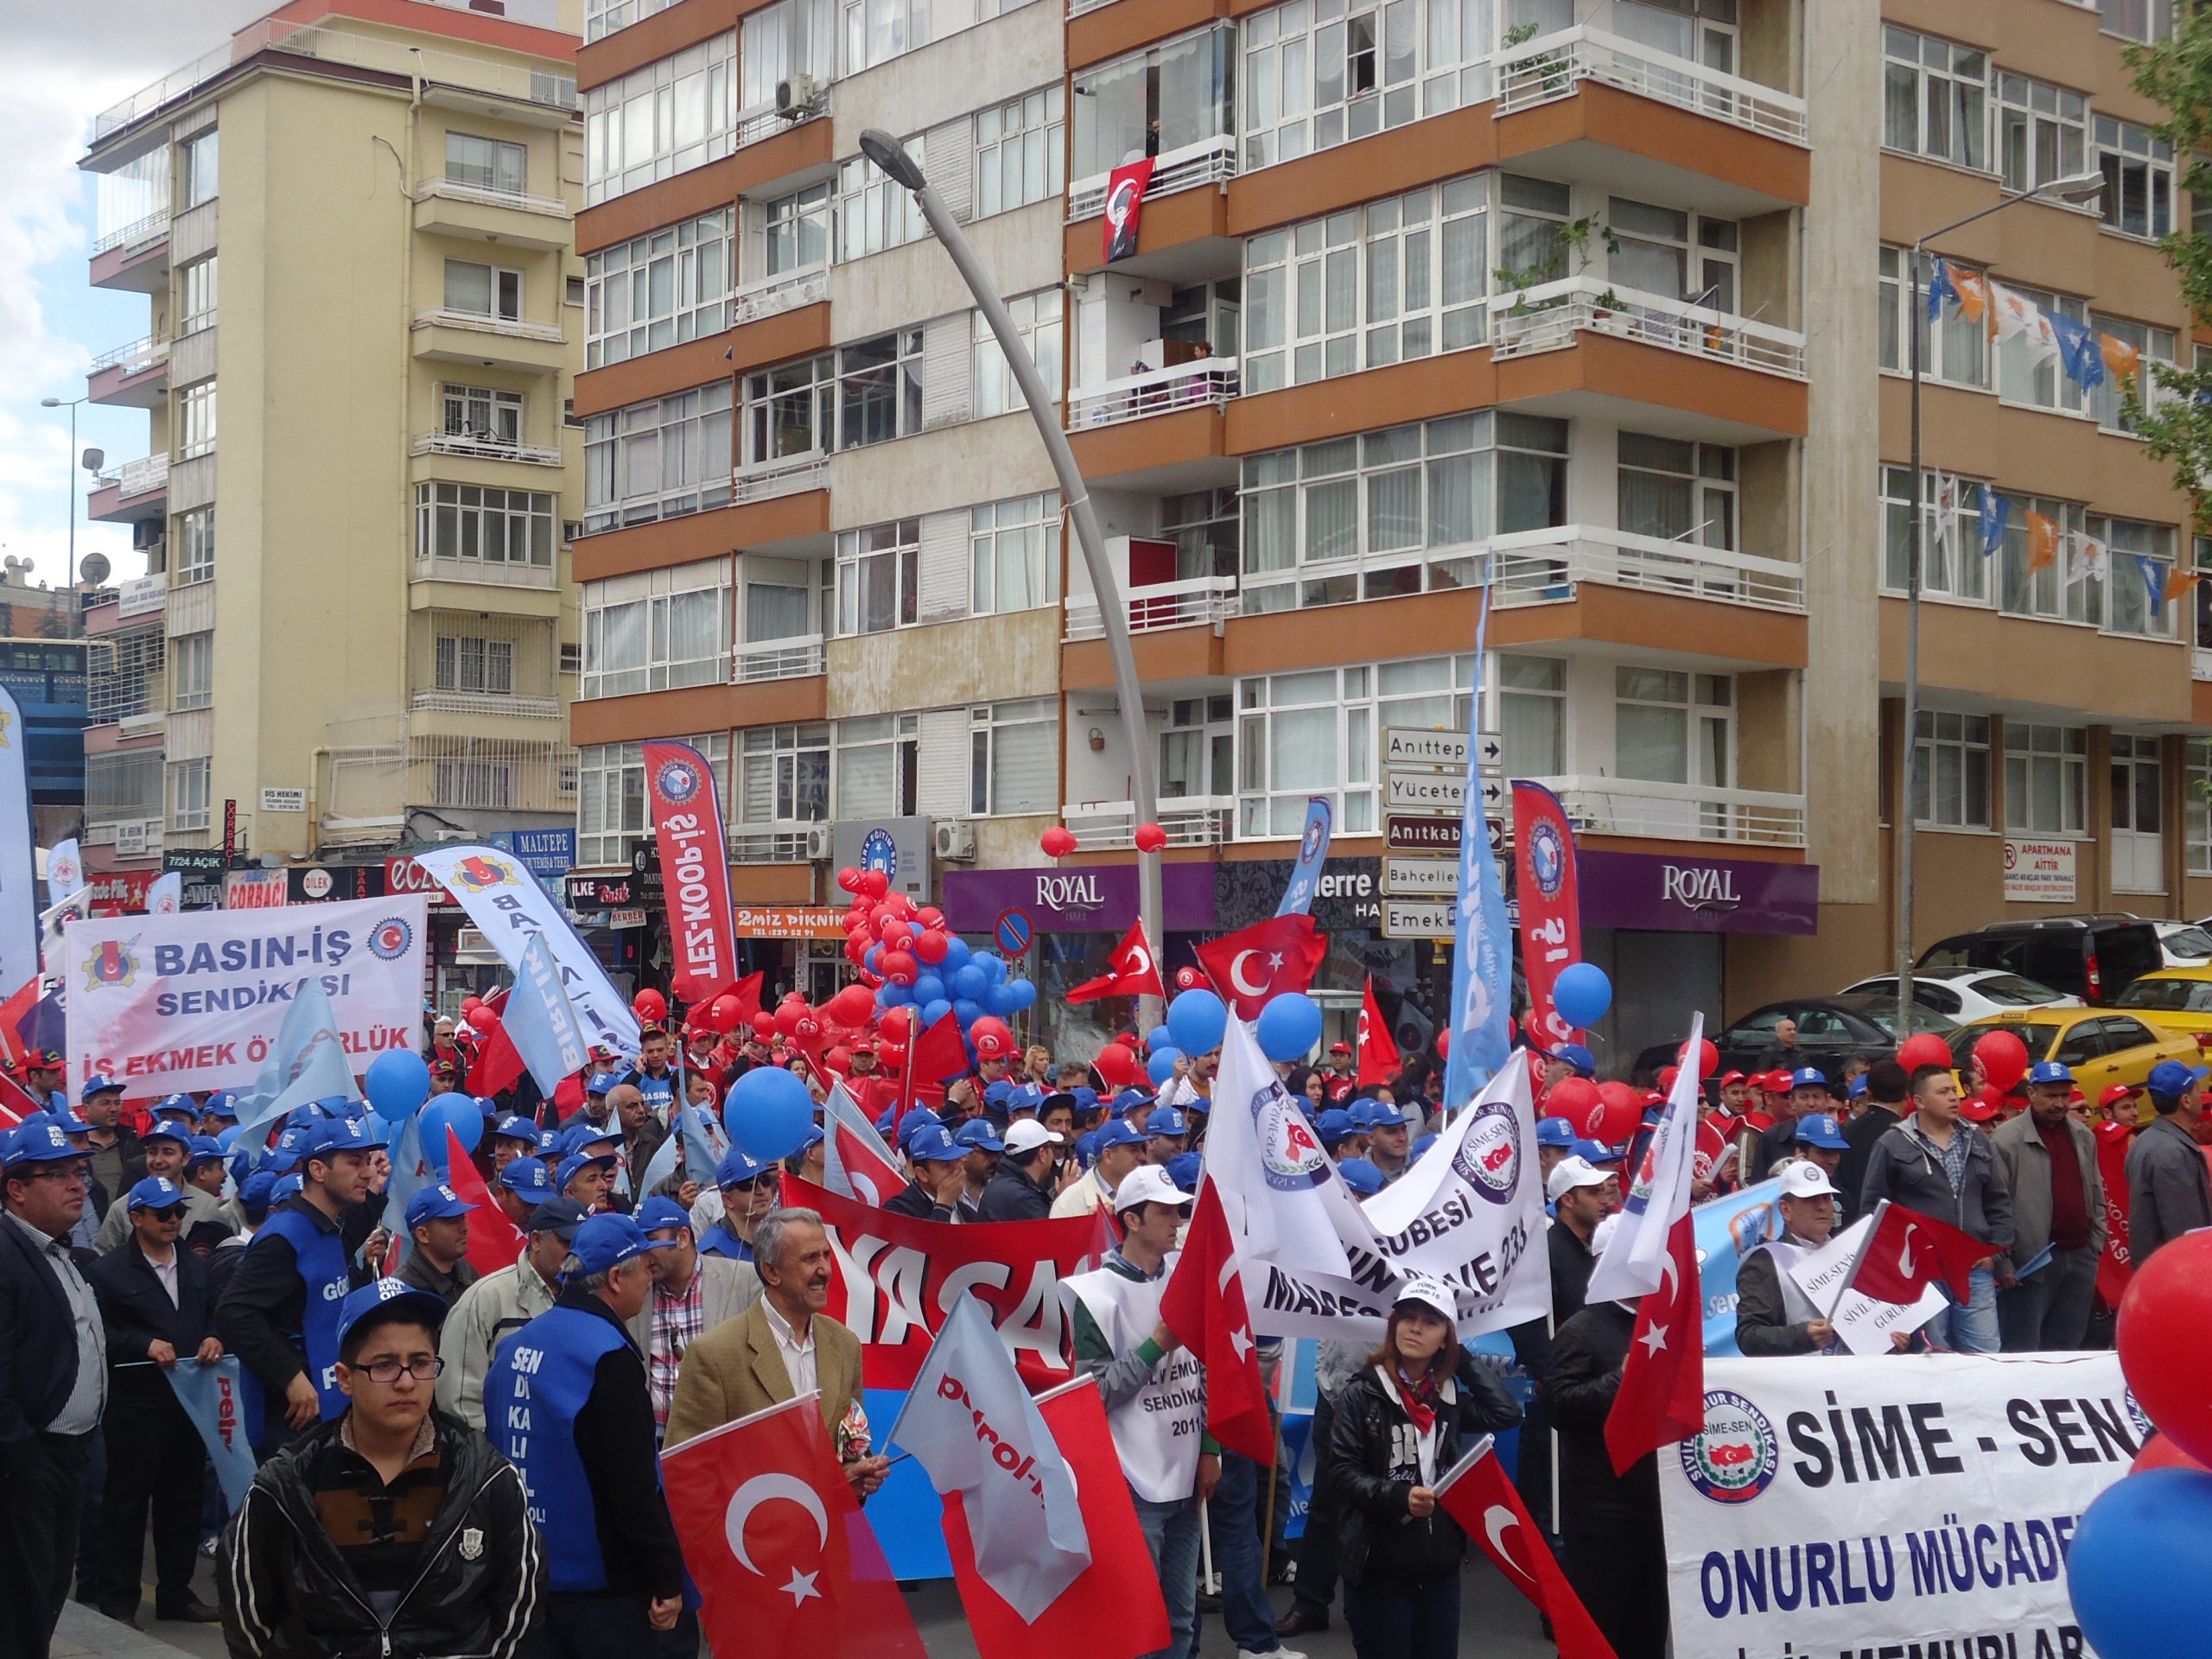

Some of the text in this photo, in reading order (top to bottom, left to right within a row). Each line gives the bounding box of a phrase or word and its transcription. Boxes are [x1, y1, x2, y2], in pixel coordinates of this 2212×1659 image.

[1390, 738, 1465, 760] Anıttep
[520, 834, 569, 853] MALTEPE
[1390, 823, 1461, 842] Anıtkab
[2021, 844, 2072, 857] APARTMANA
[192, 856, 221, 869] AÇIK
[571, 879, 594, 897] İLKE
[1036, 875, 1105, 912] ROYAL
[1314, 873, 1372, 898] ierre
[1662, 865, 1741, 908] ROYAL
[612, 911, 644, 923] BERBER
[1390, 912, 1444, 927] Emek
[155, 925, 352, 977] BASIN-İŞ
[125, 1041, 238, 1077] EKMEK
[823, 1223, 1091, 1370] YASA
[507, 1405, 531, 1431] KA
[1172, 1416, 1201, 1437] 2011
[1786, 1389, 1965, 1489] SİME
[2005, 1397, 2141, 1467] SEN
[1700, 1513, 2083, 1619] ONURLU MÜCADE
